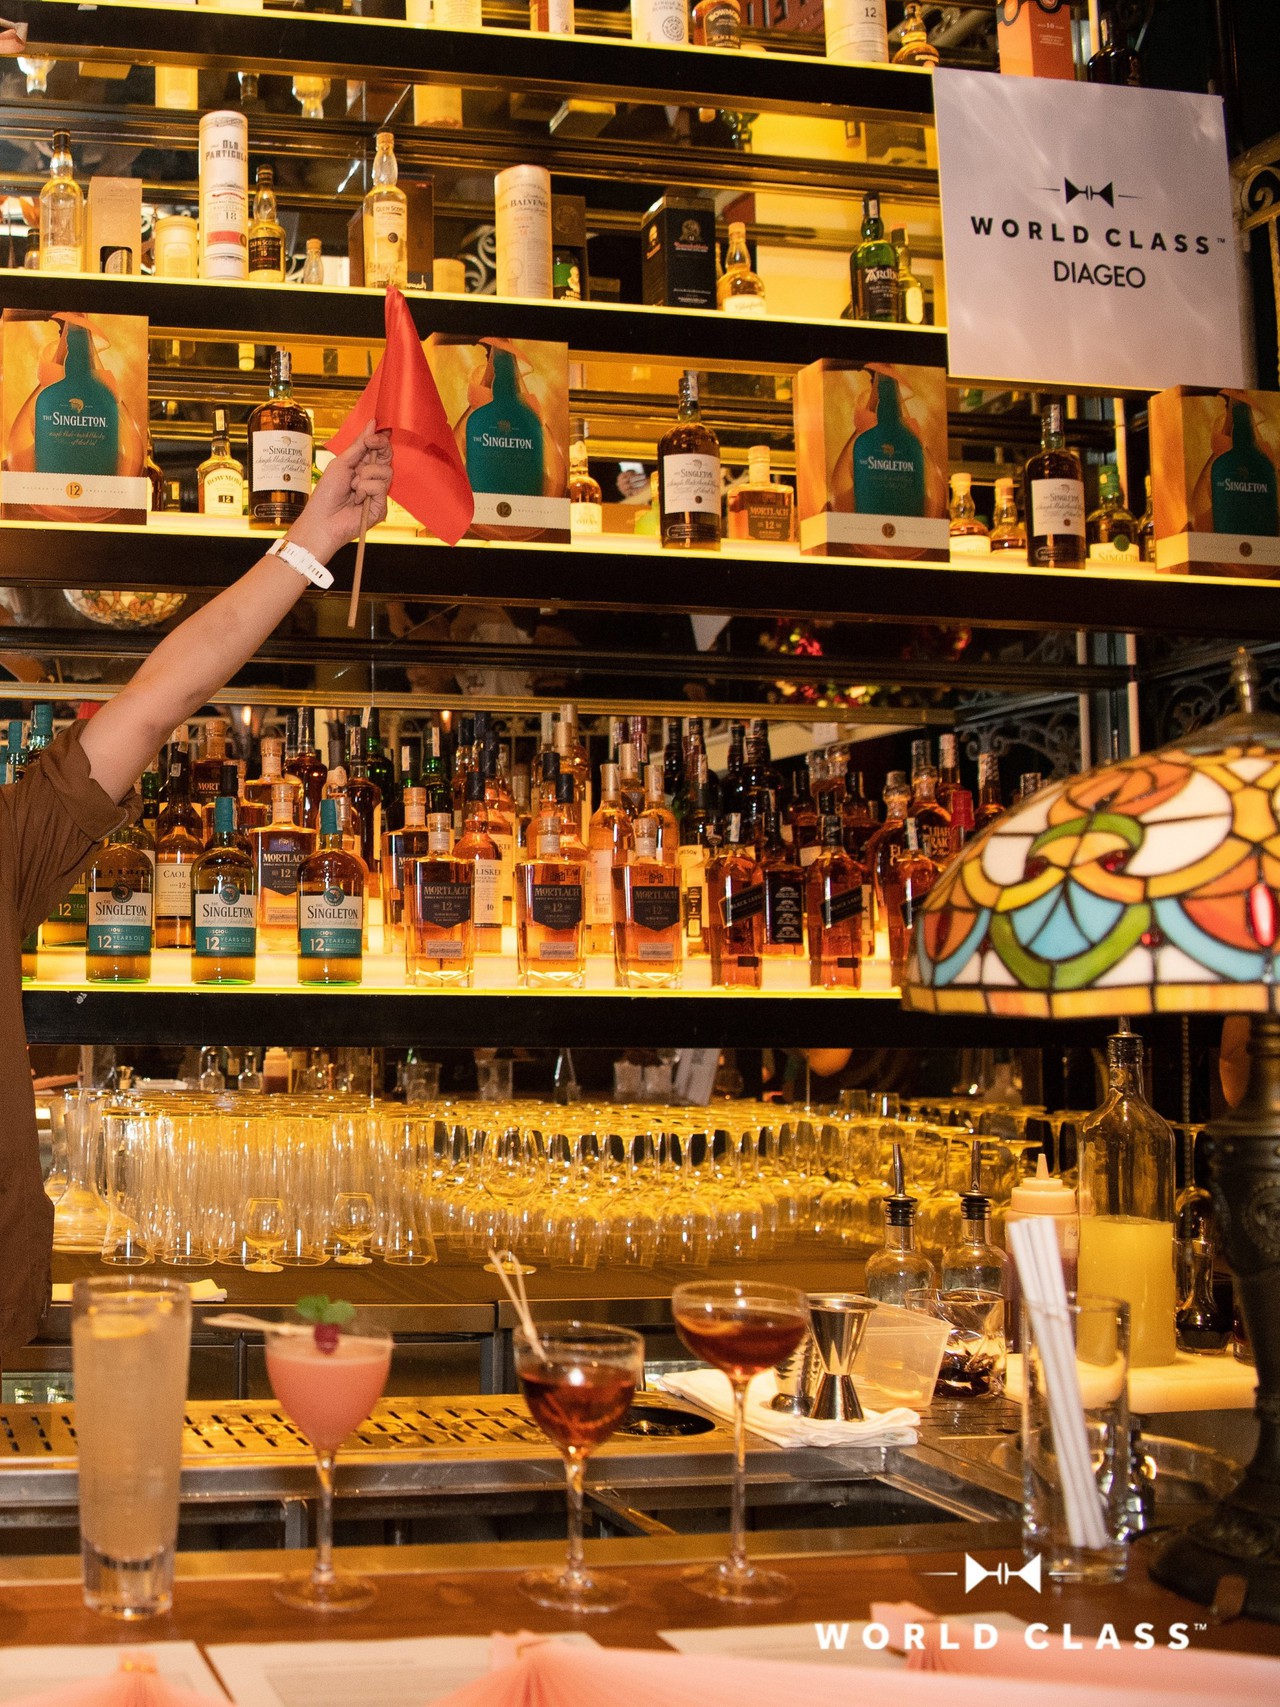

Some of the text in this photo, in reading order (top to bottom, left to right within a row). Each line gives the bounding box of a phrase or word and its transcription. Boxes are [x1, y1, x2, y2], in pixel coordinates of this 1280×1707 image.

[864, 7, 877, 18] 12
[222, 139, 239, 150] OLD
[205, 150, 247, 163] PARTICUL
[970, 215, 1090, 244] WORLD
[1053, 260, 1147, 289] DIAGEO
[268, 446, 303, 456] SINGLETON
[70, 485, 81, 495] 12
[1225, 479, 1268, 493] SINGLETON
[750, 506, 789, 516] MORTLACH
[765, 520, 774, 529] 12
[197, 781, 220, 791] MORT
[163, 870, 187, 878] CAOL
[280, 868, 291, 878] 12
[475, 868, 502, 876] LISKE
[423, 886, 469, 896] MORTLACH
[534, 887, 580, 897] MORTLACH
[635, 890, 678, 900] MORTLACH
[58, 903, 72, 916] 12
[441, 902, 453, 911] 12
[552, 902, 563, 913] 12
[651, 905, 663, 915] 12
[97, 935, 112, 948] 12
[205, 936, 219, 951] 12
[310, 937, 324, 952] 12
